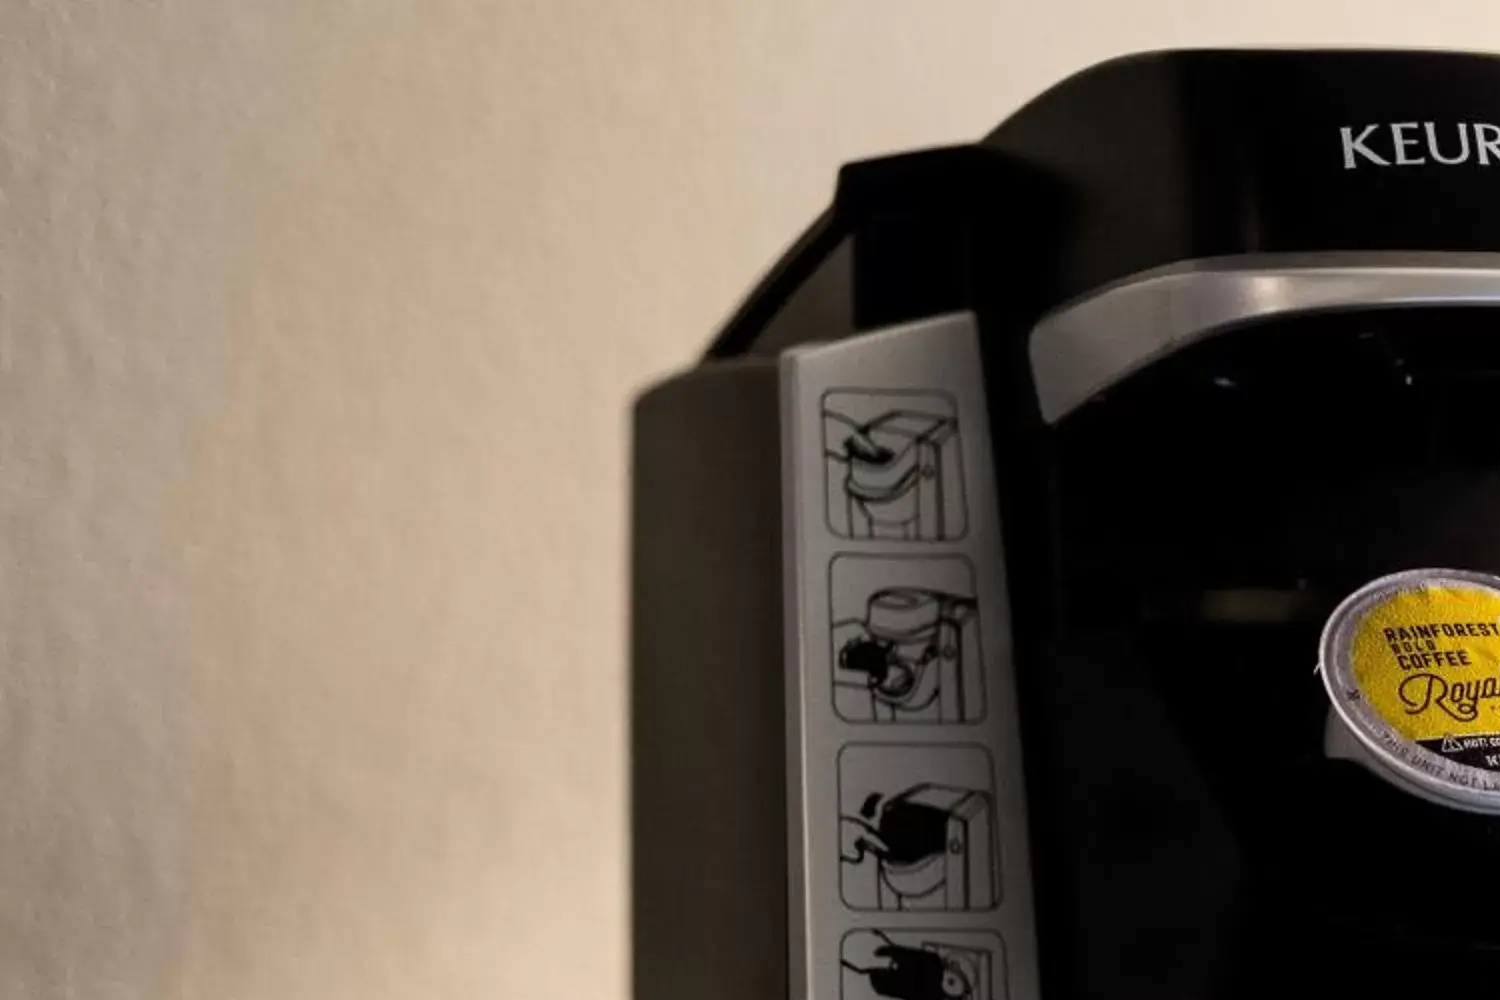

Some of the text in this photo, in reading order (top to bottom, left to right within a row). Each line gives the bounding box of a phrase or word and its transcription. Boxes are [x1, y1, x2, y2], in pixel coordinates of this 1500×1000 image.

[1384, 622, 1500, 643] RAINFOREST
[1391, 639, 1437, 655] BOLD
[1397, 650, 1472, 671] COFFEE
[1411, 754, 1445, 776] UNIT
